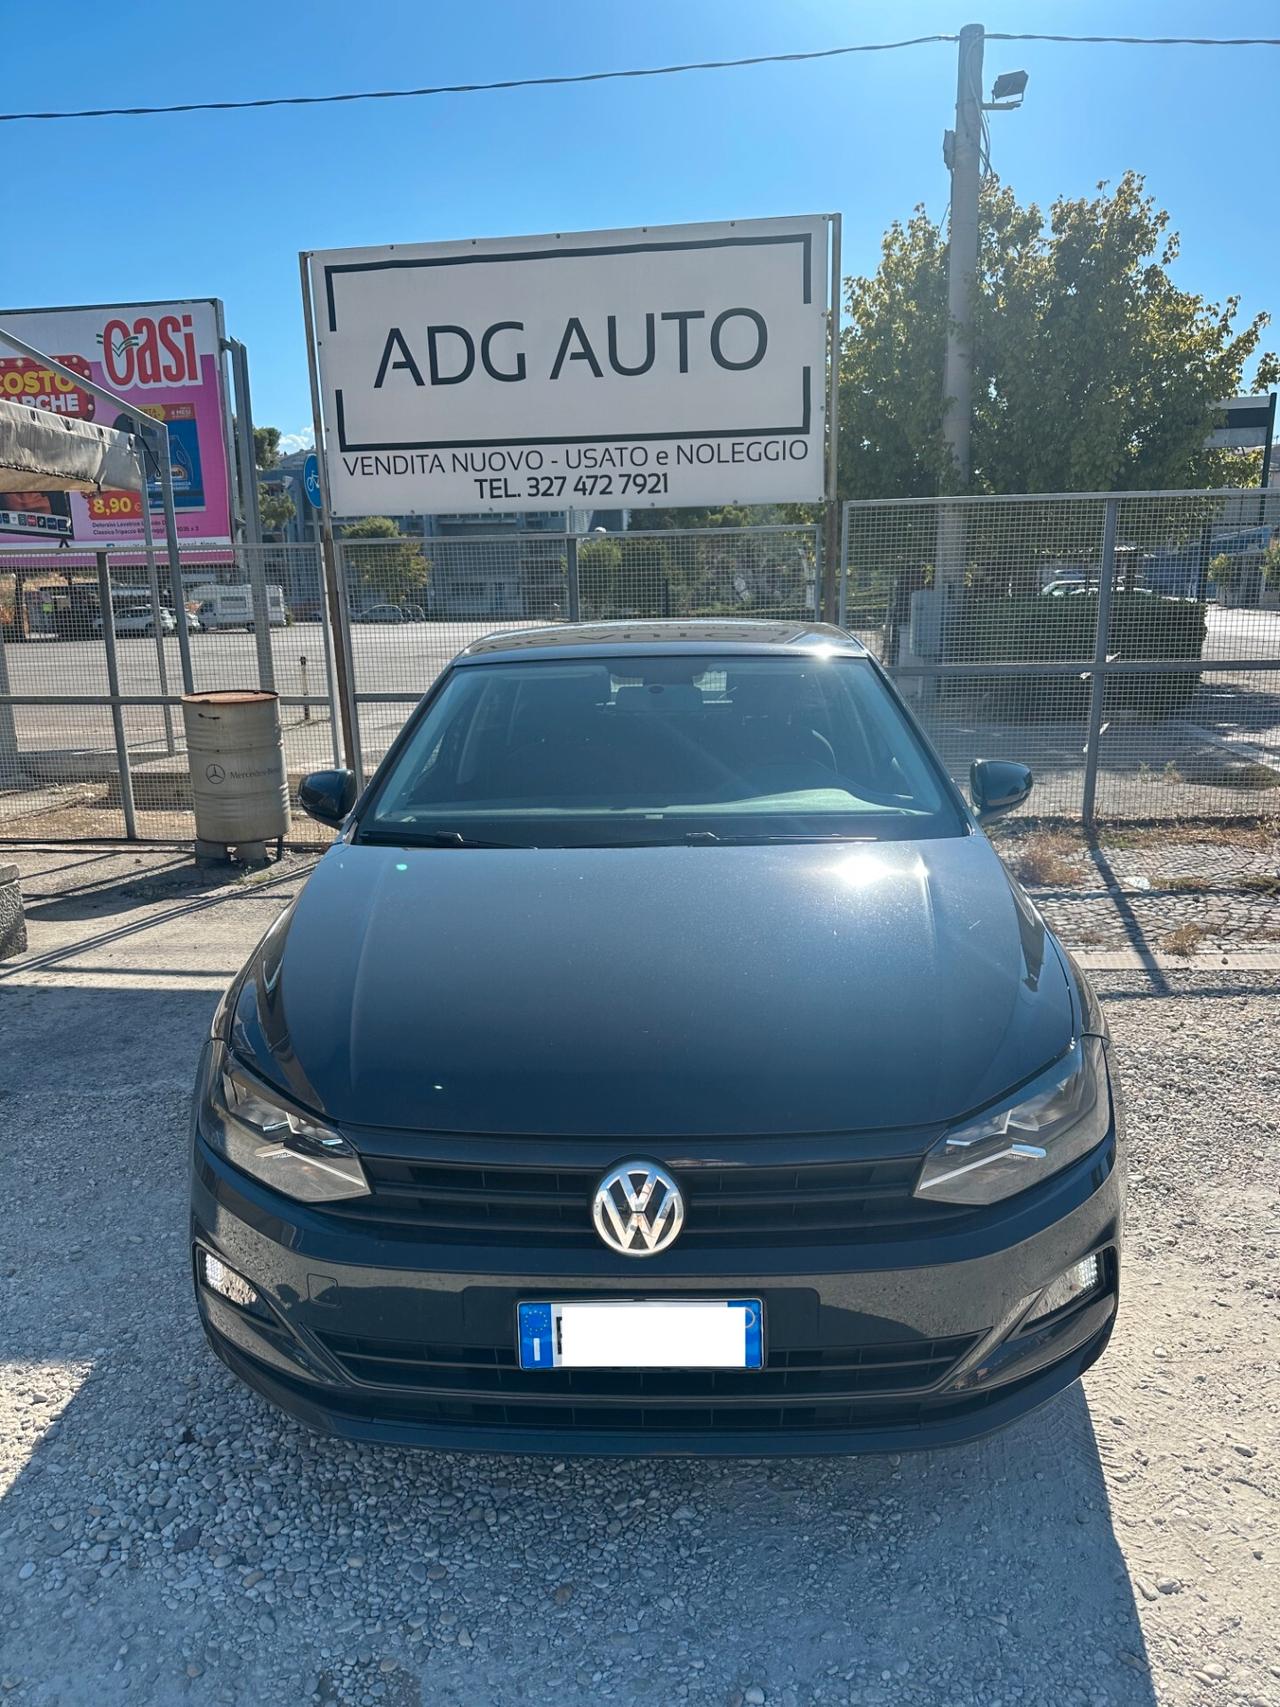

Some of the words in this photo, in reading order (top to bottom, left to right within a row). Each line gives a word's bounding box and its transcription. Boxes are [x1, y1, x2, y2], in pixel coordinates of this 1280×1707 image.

[374, 321, 526, 388] ADG
[549, 308, 768, 380] AUTO
[0, 370, 75, 394] OSTO
[343, 454, 445, 476] VENDITA
[452, 450, 543, 473] NUOVO
[566, 446, 648, 469] USATO
[656, 450, 669, 466] e
[677, 440, 808, 465] NOLEGGIO
[474, 478, 521, 499] TEL.
[527, 476, 567, 497] 327
[573, 475, 613, 496] 472
[619, 472, 668, 494] 7921
[93, 498, 131, 515] 8,90
